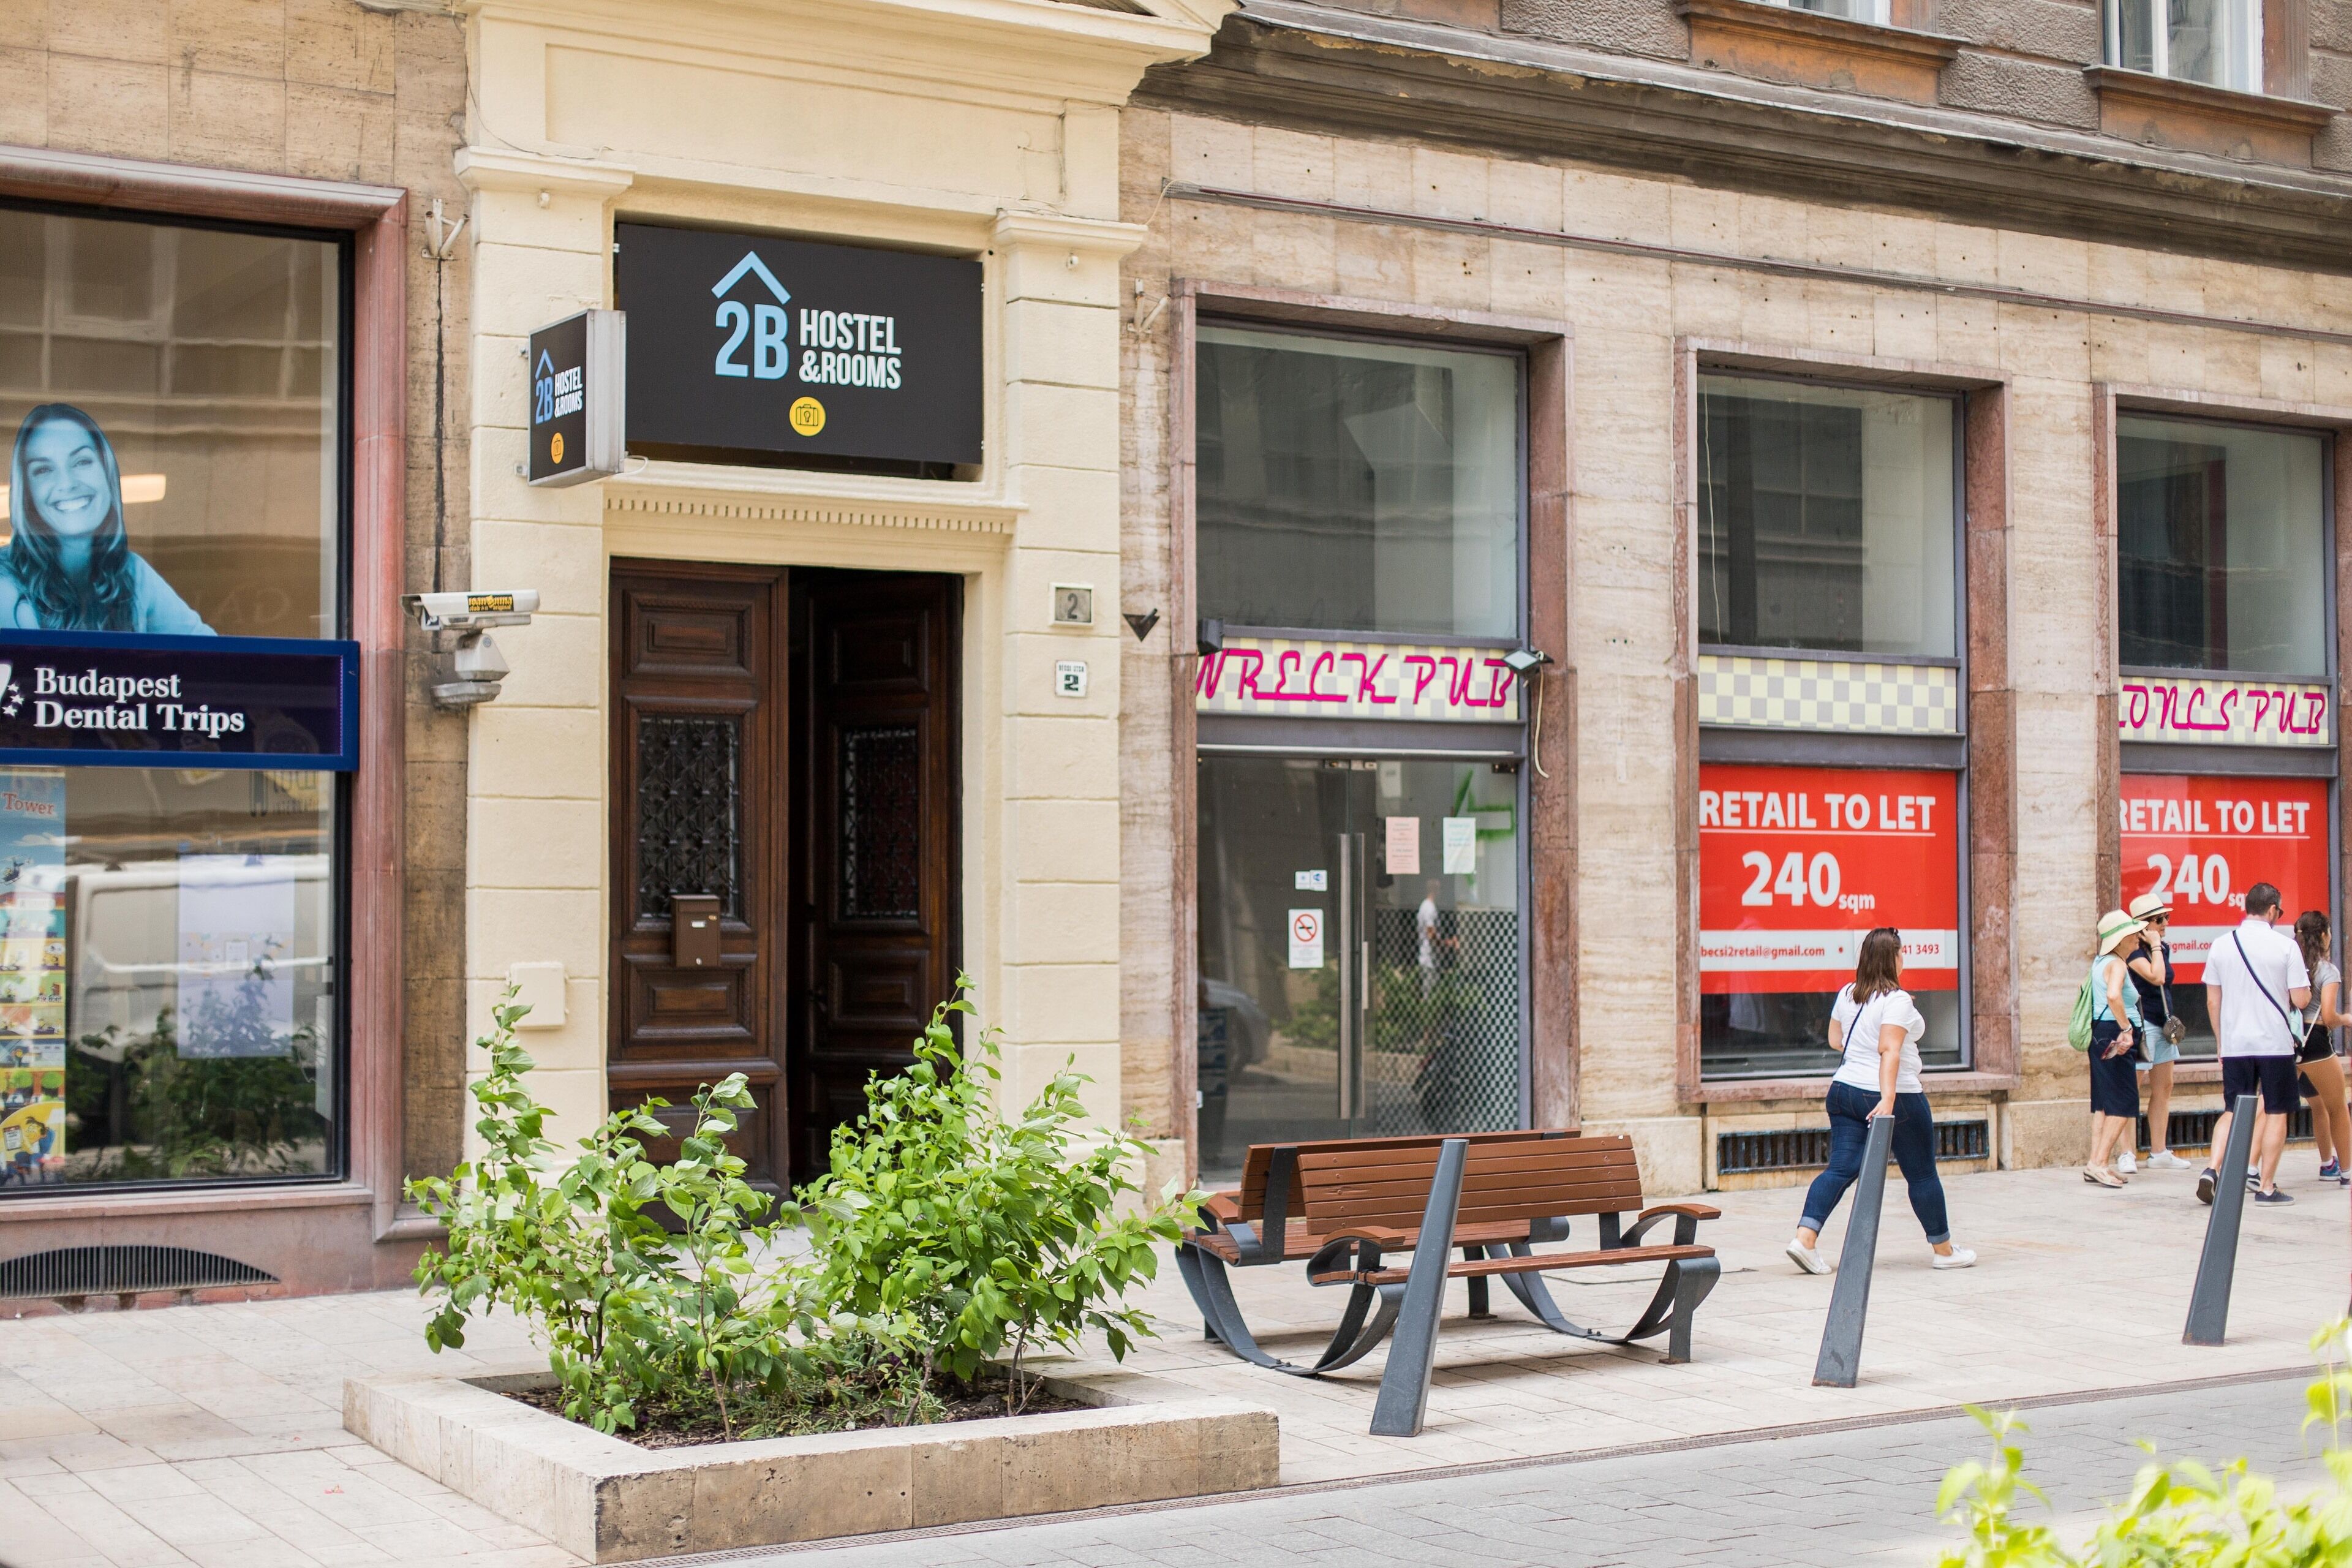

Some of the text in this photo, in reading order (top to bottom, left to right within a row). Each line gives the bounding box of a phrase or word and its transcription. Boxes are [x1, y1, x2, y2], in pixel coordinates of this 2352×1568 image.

[715, 300, 790, 380] 2B
[800, 308, 902, 355] HOSTEL
[555, 366, 582, 397] HOSTEL
[799, 351, 902, 390] &ROOMS
[535, 376, 554, 424] 2B
[554, 390, 582, 418] &ROOMS
[1068, 592, 1078, 619] 2
[34, 667, 181, 704] Budapest
[1064, 674, 1079, 692] 2
[1404, 655, 1514, 708] PUB
[34, 700, 245, 739] Dental Trips
[2119, 684, 2326, 734] ONCS PUB
[4, 793, 55, 815] Tower
[1699, 790, 1936, 831] RETAIL TO LET
[2215, 801, 2255, 833] TO
[2261, 802, 2310, 834] LET
[1741, 850, 1875, 914] 240 sqm
[2147, 853, 2247, 911] 240 sq
[1700, 944, 1825, 960] becsi2retail@gmail.com
[1916, 943, 1939, 954] 3493
